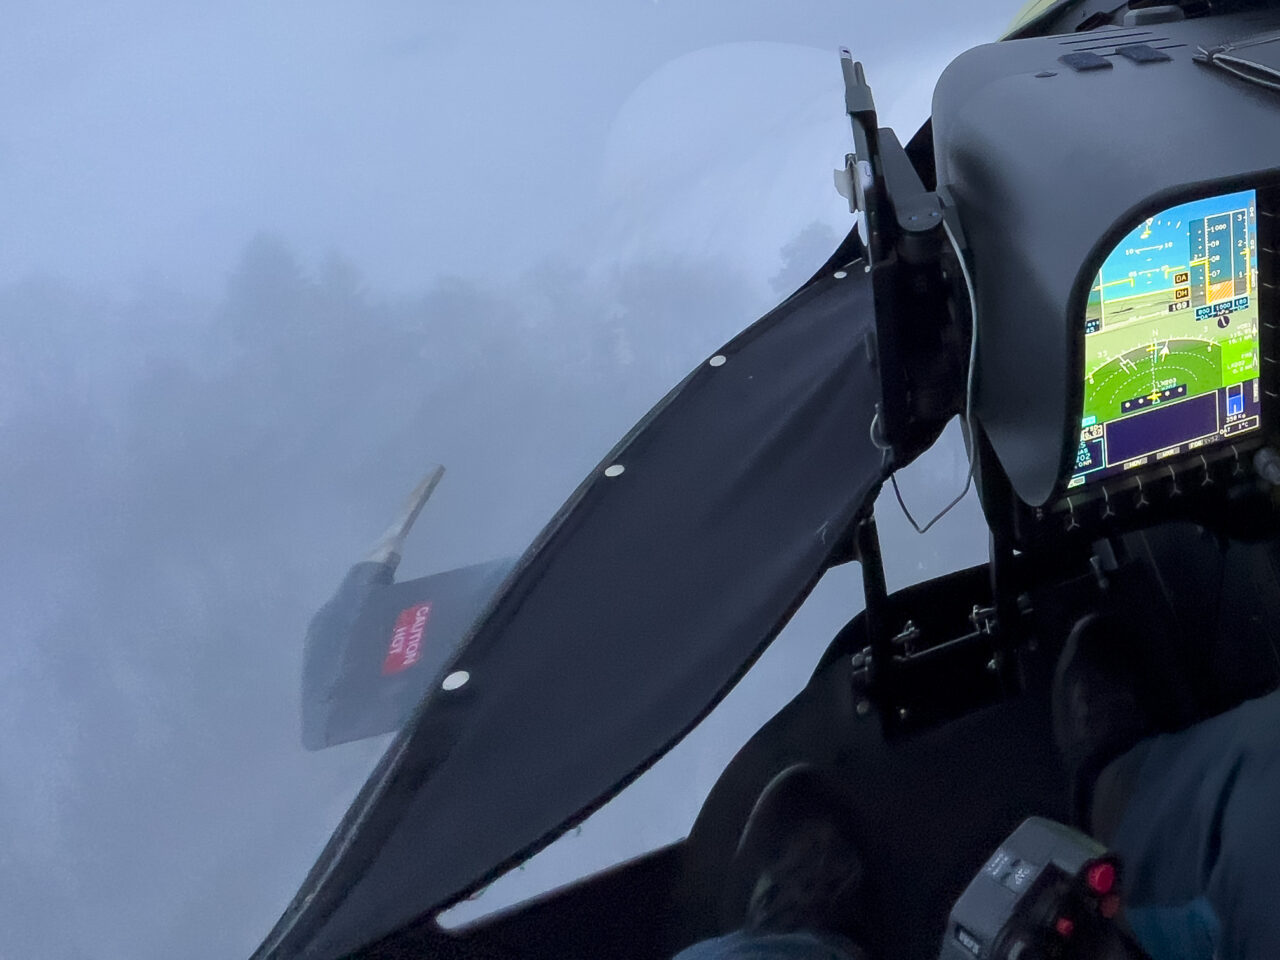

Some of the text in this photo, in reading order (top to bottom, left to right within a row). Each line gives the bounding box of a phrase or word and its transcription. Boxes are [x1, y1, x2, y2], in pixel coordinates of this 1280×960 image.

[1176, 274, 1187, 282] DA
[1176, 290, 1188, 298] DH
[403, 606, 429, 664] CAUTION
